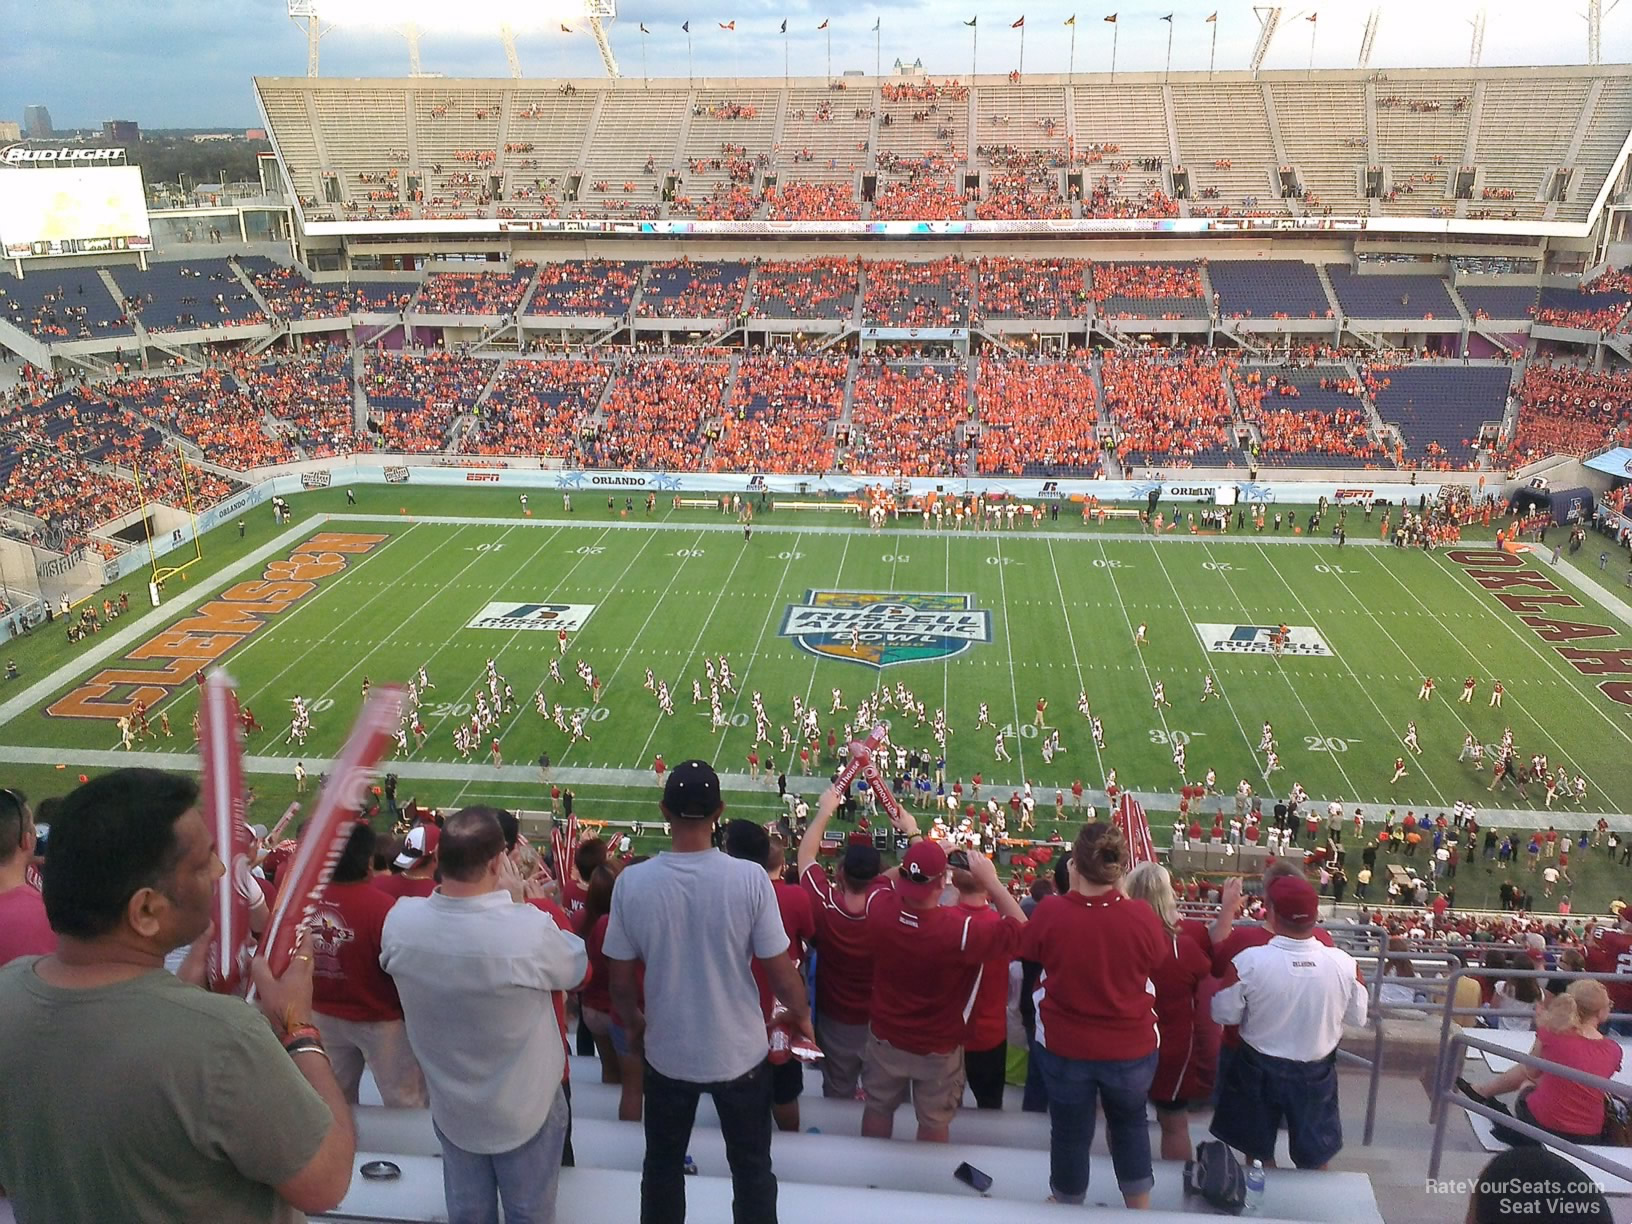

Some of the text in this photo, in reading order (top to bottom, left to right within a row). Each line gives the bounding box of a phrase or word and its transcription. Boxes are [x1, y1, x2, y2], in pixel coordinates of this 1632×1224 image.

[7, 148, 125, 160] BUD LIGHT
[466, 472, 500, 482] ESPN
[592, 476, 646, 486] ORLANDO
[1171, 487, 1216, 496] ORLAN
[1334, 489, 1375, 498] ESPN
[219, 499, 246, 518] ORLANDO
[480, 617, 577, 626] RUSSELL
[795, 611, 978, 625] RUSSELL
[797, 620, 981, 633] ATHLETIC
[832, 632, 937, 643] BOWL
[428, 702, 472, 717] 20
[1000, 723, 1038, 738] 40
[1148, 730, 1189, 745] 30
[1303, 736, 1349, 752] 20
[843, 760, 860, 784] house
[872, 780, 889, 804] house
